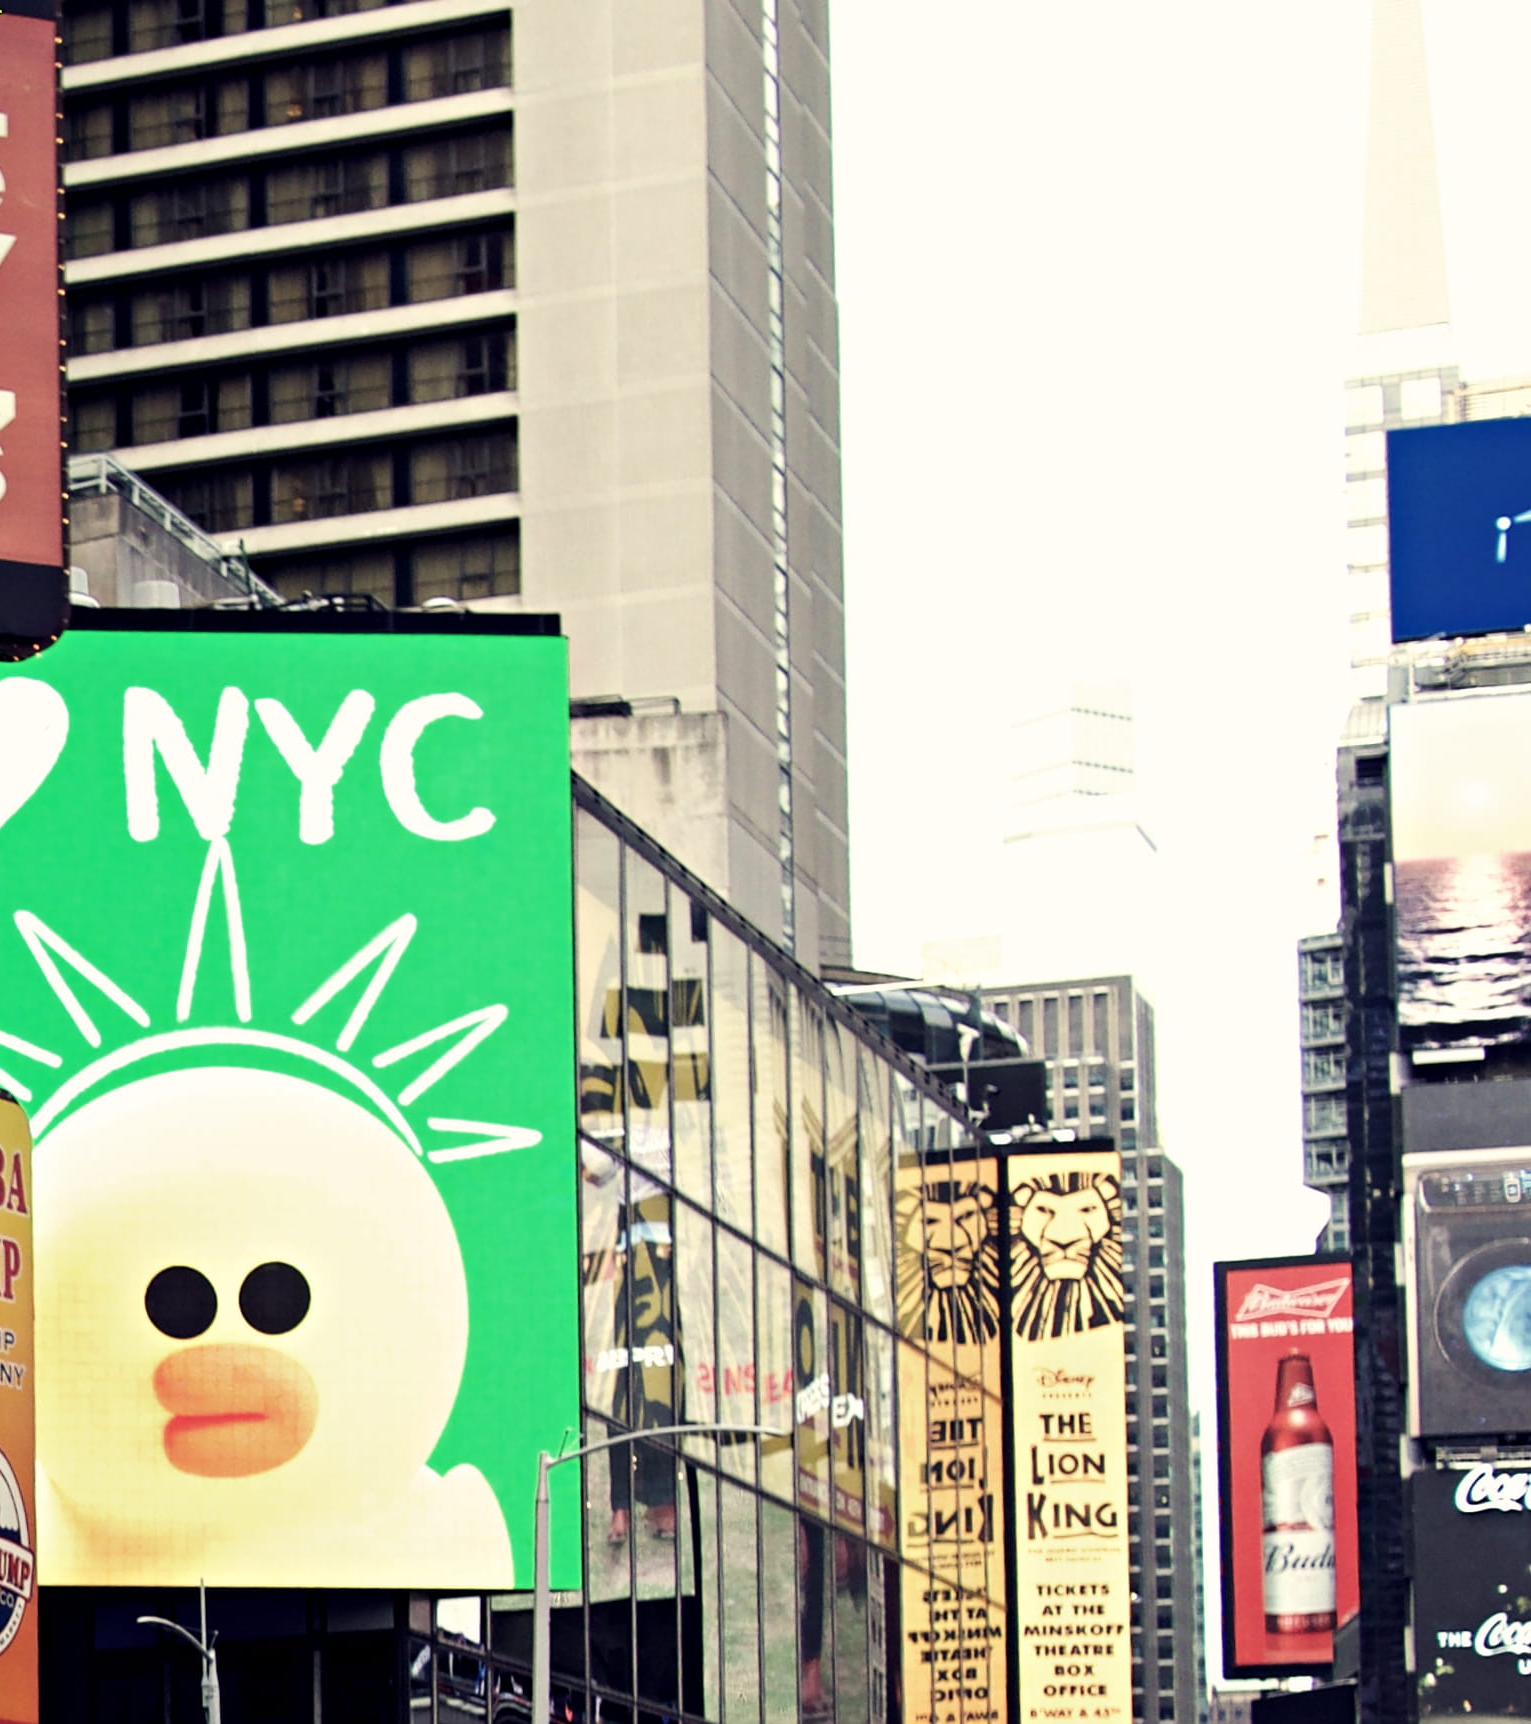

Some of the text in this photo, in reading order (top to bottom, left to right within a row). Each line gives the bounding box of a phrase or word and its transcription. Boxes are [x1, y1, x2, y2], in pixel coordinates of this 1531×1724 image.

[122, 686, 496, 846] NYC
[1039, 1412, 1092, 1435] THE
[1030, 1445, 1106, 1486] LION
[1027, 1492, 1119, 1541] KING
[1036, 1585, 1110, 1597] TICKETS
[1042, 1604, 1105, 1616] AT THE
[1023, 1624, 1124, 1637] MINSKOFF
[1438, 1631, 1473, 1649] THE
[1034, 1644, 1114, 1657] THEATRE
[1054, 1664, 1095, 1677] BOX
[1042, 1684, 1107, 1698] OFFICE
